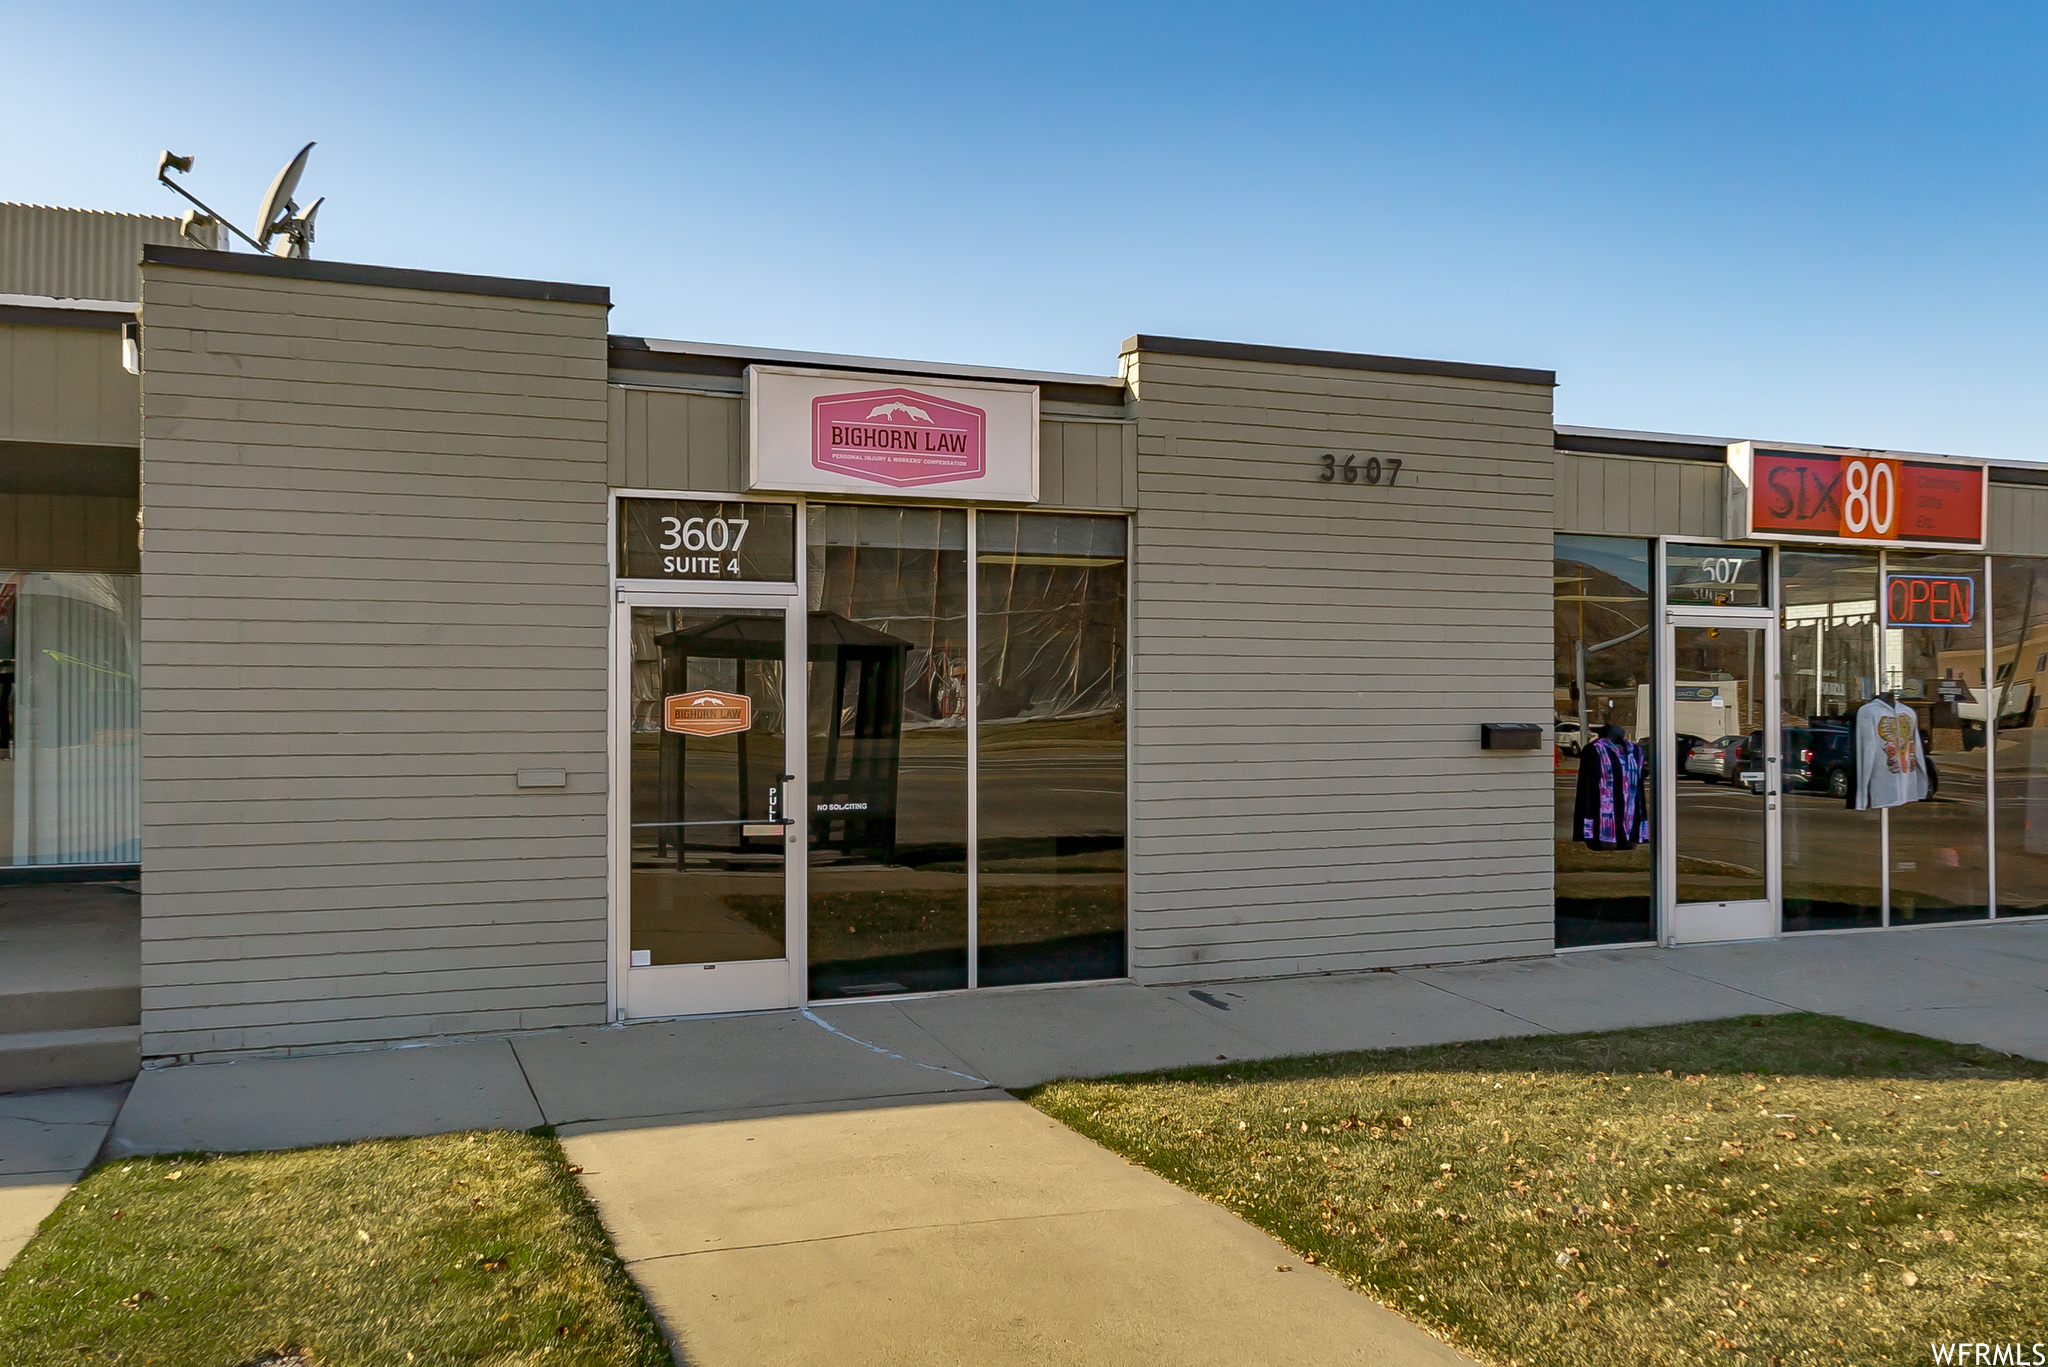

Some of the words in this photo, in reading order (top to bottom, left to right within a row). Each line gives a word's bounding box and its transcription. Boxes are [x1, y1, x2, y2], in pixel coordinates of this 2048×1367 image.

[831, 426, 918, 450] BIGHORN
[925, 432, 968, 453] LAW
[864, 455, 886, 463] INJURY
[923, 459, 967, 467] COMPENSATION
[1320, 453, 1403, 486] 3607
[1767, 465, 1844, 521] SIX
[1844, 460, 1895, 535] 80
[660, 516, 750, 552] 3607
[663, 556, 720, 573] SUITE
[727, 558, 740, 574] 4
[1888, 580, 1970, 622] OPEN
[674, 709, 716, 719] BIGHORN
[720, 709, 741, 719] LAW
[769, 787, 777, 822] PULL
